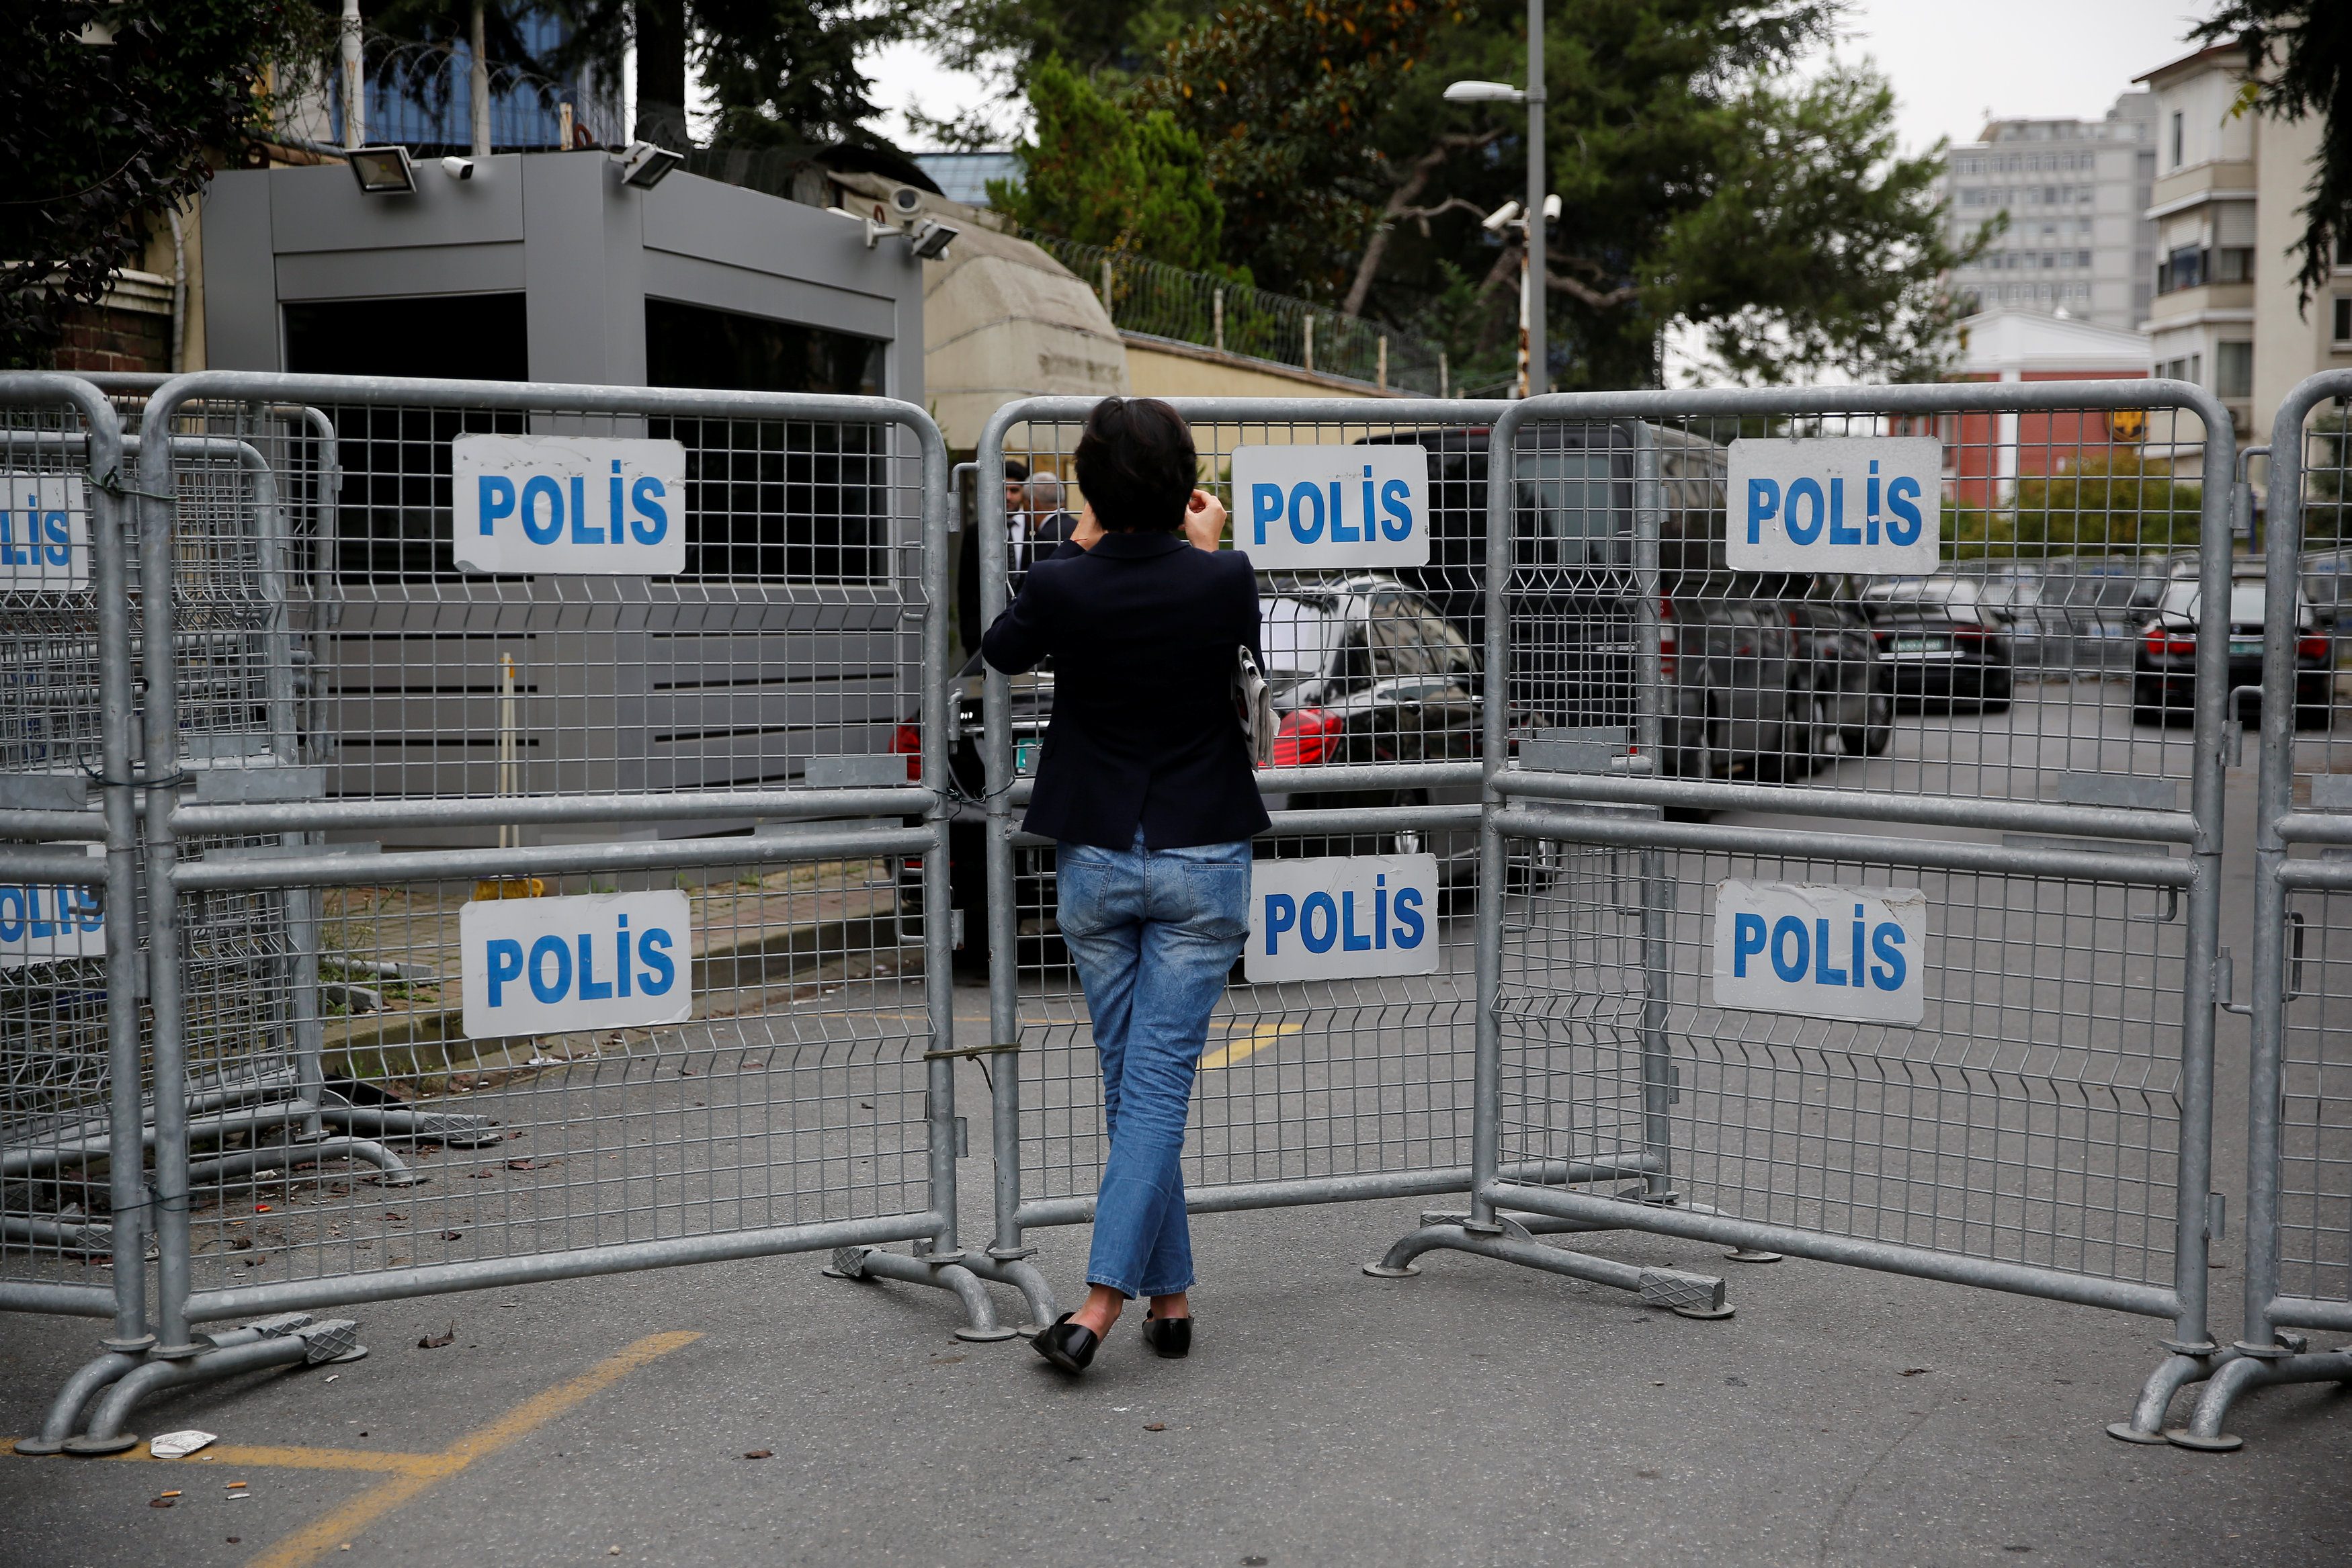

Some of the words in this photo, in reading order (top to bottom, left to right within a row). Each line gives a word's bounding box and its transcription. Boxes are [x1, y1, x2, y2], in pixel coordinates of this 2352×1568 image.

[0, 495, 70, 566] LİS
[478, 460, 668, 545] POLİS
[1252, 464, 1413, 545] POLİS
[1747, 460, 1922, 547] POLİS
[1265, 873, 1425, 955] POLİS
[1734, 904, 1906, 992] POLİS
[487, 913, 675, 1008] POLİS
